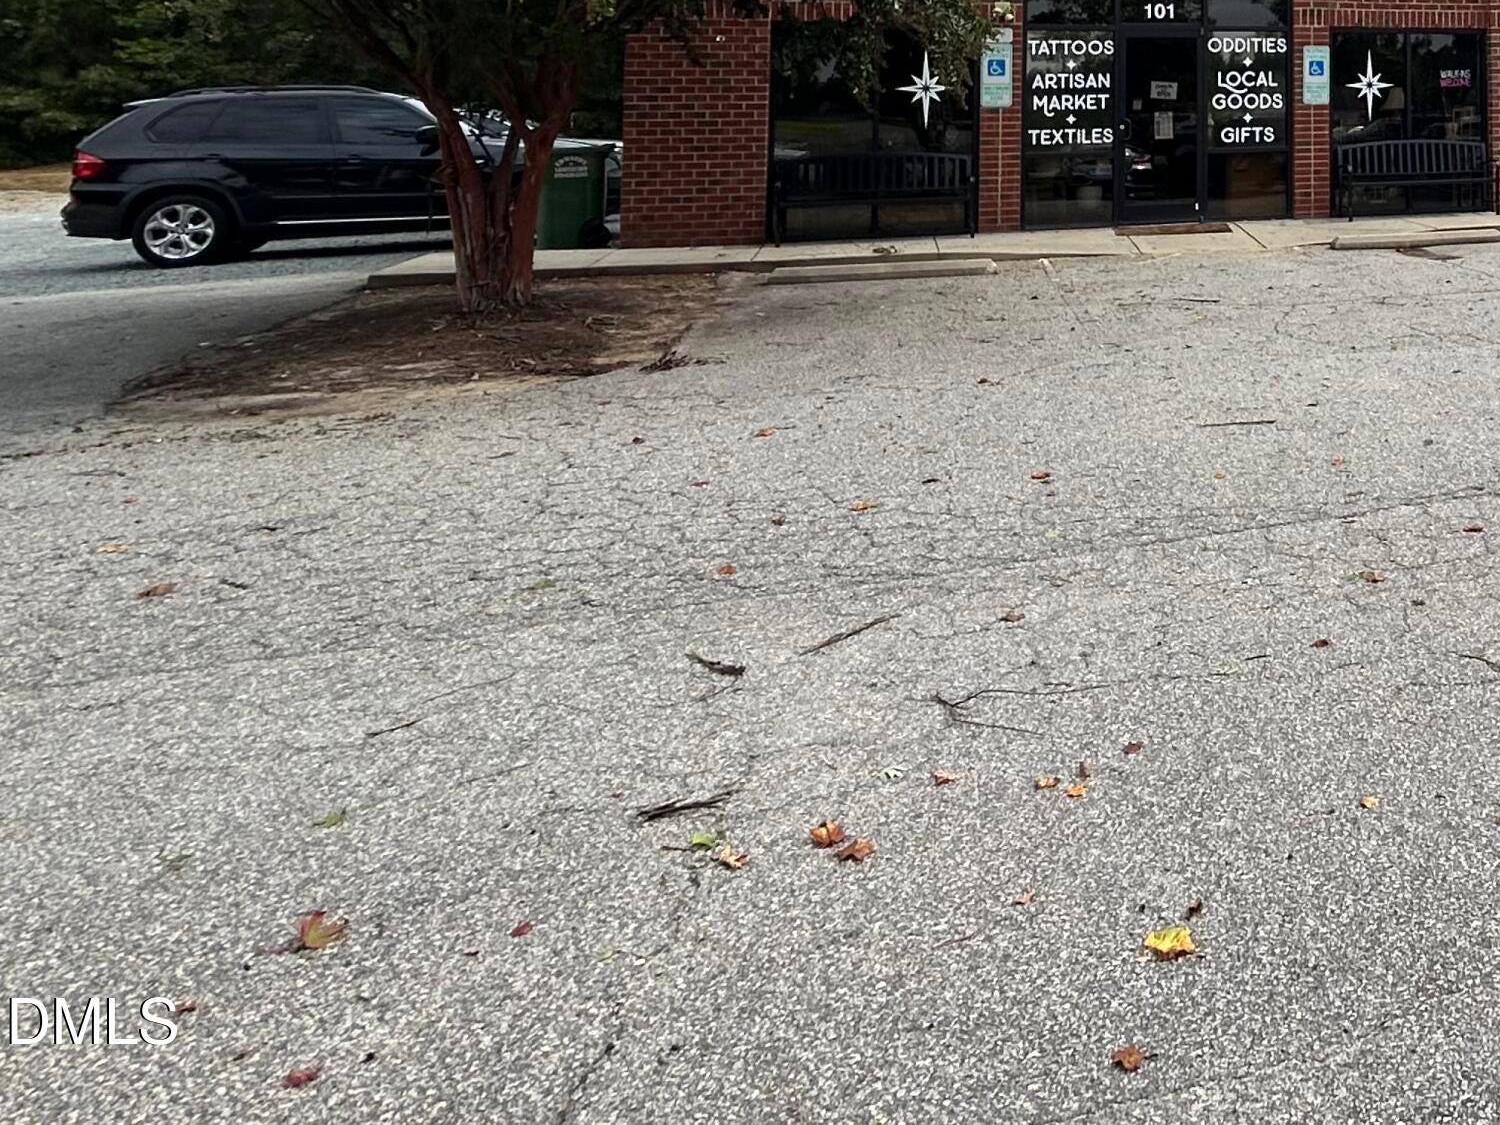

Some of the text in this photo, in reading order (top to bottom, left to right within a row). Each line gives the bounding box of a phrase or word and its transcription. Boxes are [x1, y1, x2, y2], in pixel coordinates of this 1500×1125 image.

[1144, 3, 1175, 19] 101
[1027, 39, 1115, 55] TATTOOS
[1207, 37, 1287, 53] ODDITIES
[1031, 73, 1111, 89] ARTISAN
[1217, 70, 1279, 94] LOCAL
[1033, 94, 1110, 117] MARKET
[1211, 93, 1284, 110] GOODS
[1027, 128, 1114, 145] TEXTILES
[1220, 126, 1275, 143] GIFTS
